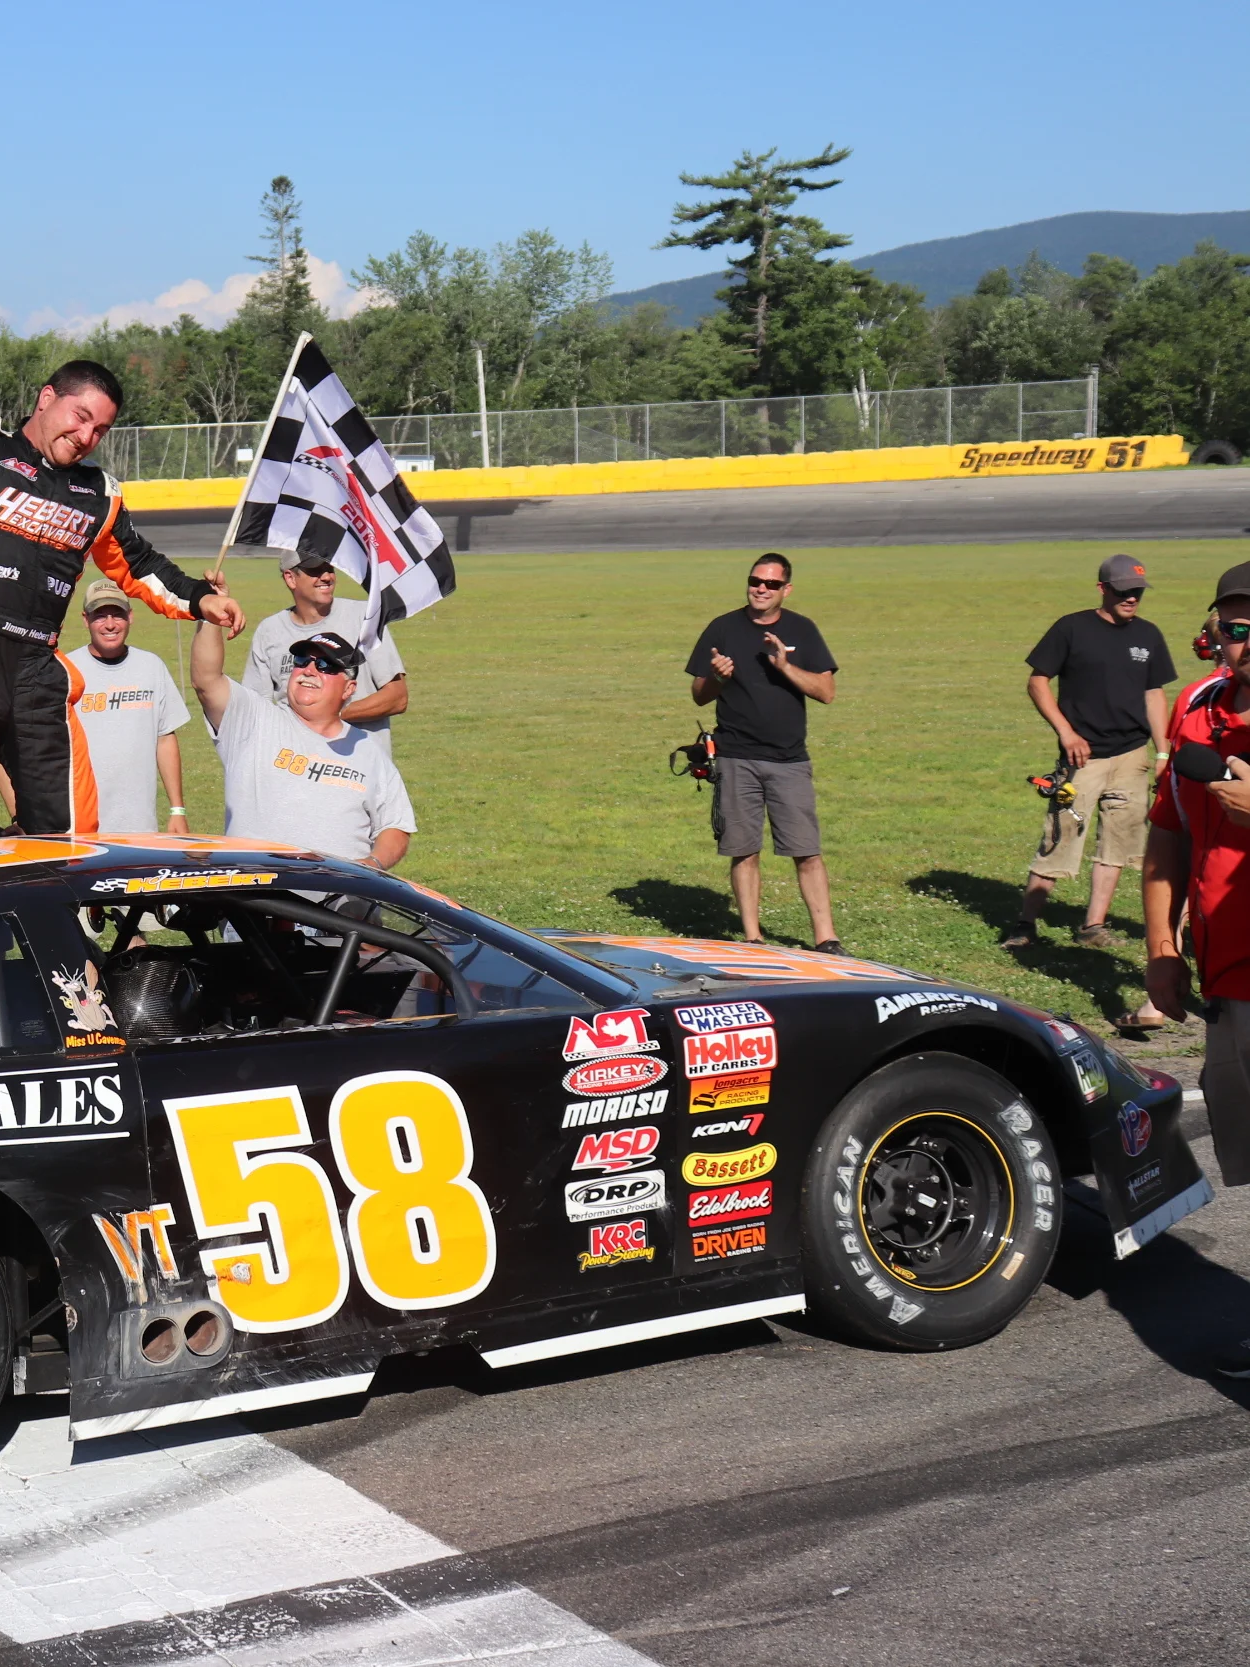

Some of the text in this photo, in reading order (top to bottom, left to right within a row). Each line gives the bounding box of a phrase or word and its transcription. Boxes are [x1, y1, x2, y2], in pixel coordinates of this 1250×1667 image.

[959, 440, 1148, 473] Speedway 51
[9, 513, 89, 550] EXCAVATION
[47, 576, 72, 598] PUB
[2, 621, 29, 637] Jimmy
[81, 690, 154, 713] 58 HEBERT
[274, 748, 309, 776] 58
[308, 762, 367, 782] HEBERT
[124, 873, 278, 894] HEBERT
[149, 868, 241, 884] Jimmy
[678, 1003, 758, 1025] QUARTER
[875, 992, 998, 1023] AMERICAN
[920, 1003, 967, 1016] RACER
[696, 1011, 768, 1032] MASTER
[66, 1035, 86, 1049] Miss
[88, 1034, 95, 1046] U
[686, 1033, 774, 1067] Holley
[576, 1063, 644, 1084] KIRKEY
[689, 1058, 759, 1075] HP CARBS
[577, 1082, 603, 1090] RACING
[713, 1076, 760, 1091] Longacre
[726, 1090, 760, 1099] RACING
[561, 1089, 670, 1129] MOROSO
[719, 1095, 766, 1106] PRODUCTS
[692, 1118, 752, 1138] KONI
[574, 1126, 661, 1166] MSD
[693, 1149, 767, 1178] Bassett
[999, 1102, 1052, 1232] RACER
[162, 1069, 498, 1335] 58
[583, 1181, 649, 1204] DRP
[689, 1187, 770, 1219] Edelbrock
[571, 1207, 625, 1221] Performance
[591, 1219, 647, 1257] KRC
[834, 1135, 925, 1325] AMERICAN
[693, 1227, 766, 1258] DRIVEN
[726, 1247, 752, 1257] RACING
[578, 1246, 655, 1272] Power Steering
